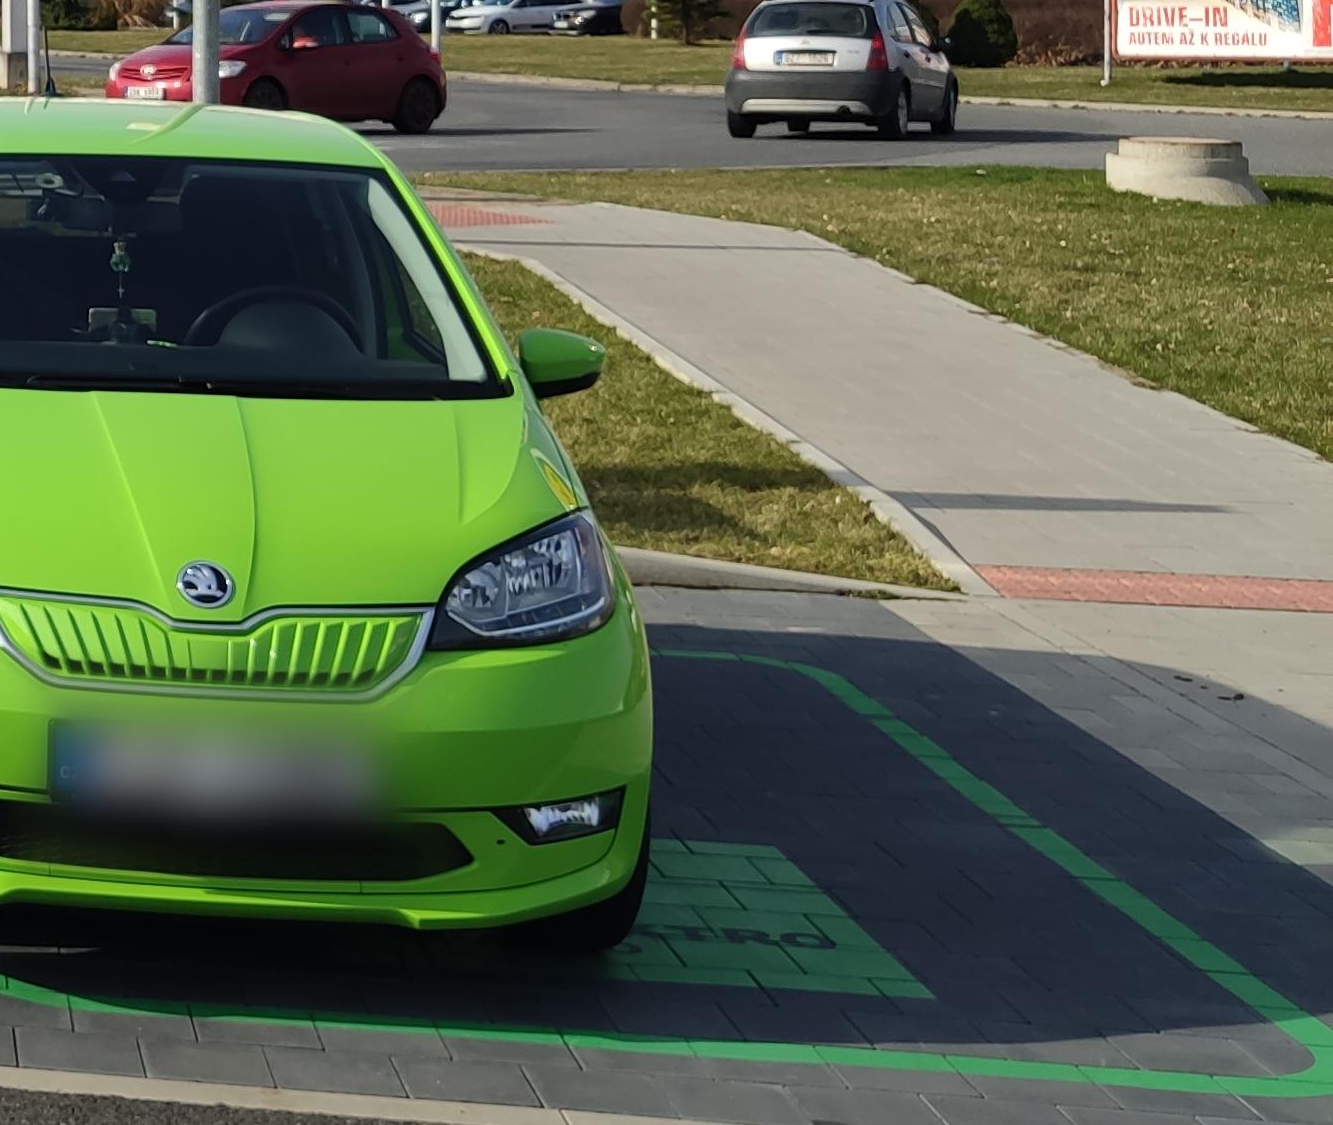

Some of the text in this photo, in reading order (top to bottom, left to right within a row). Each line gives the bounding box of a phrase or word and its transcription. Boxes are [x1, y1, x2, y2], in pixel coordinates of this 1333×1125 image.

[1129, 6, 1228, 27] DRIVE-IN
[1129, 29, 1267, 46] AUTEM AŽ K REGÁLU
